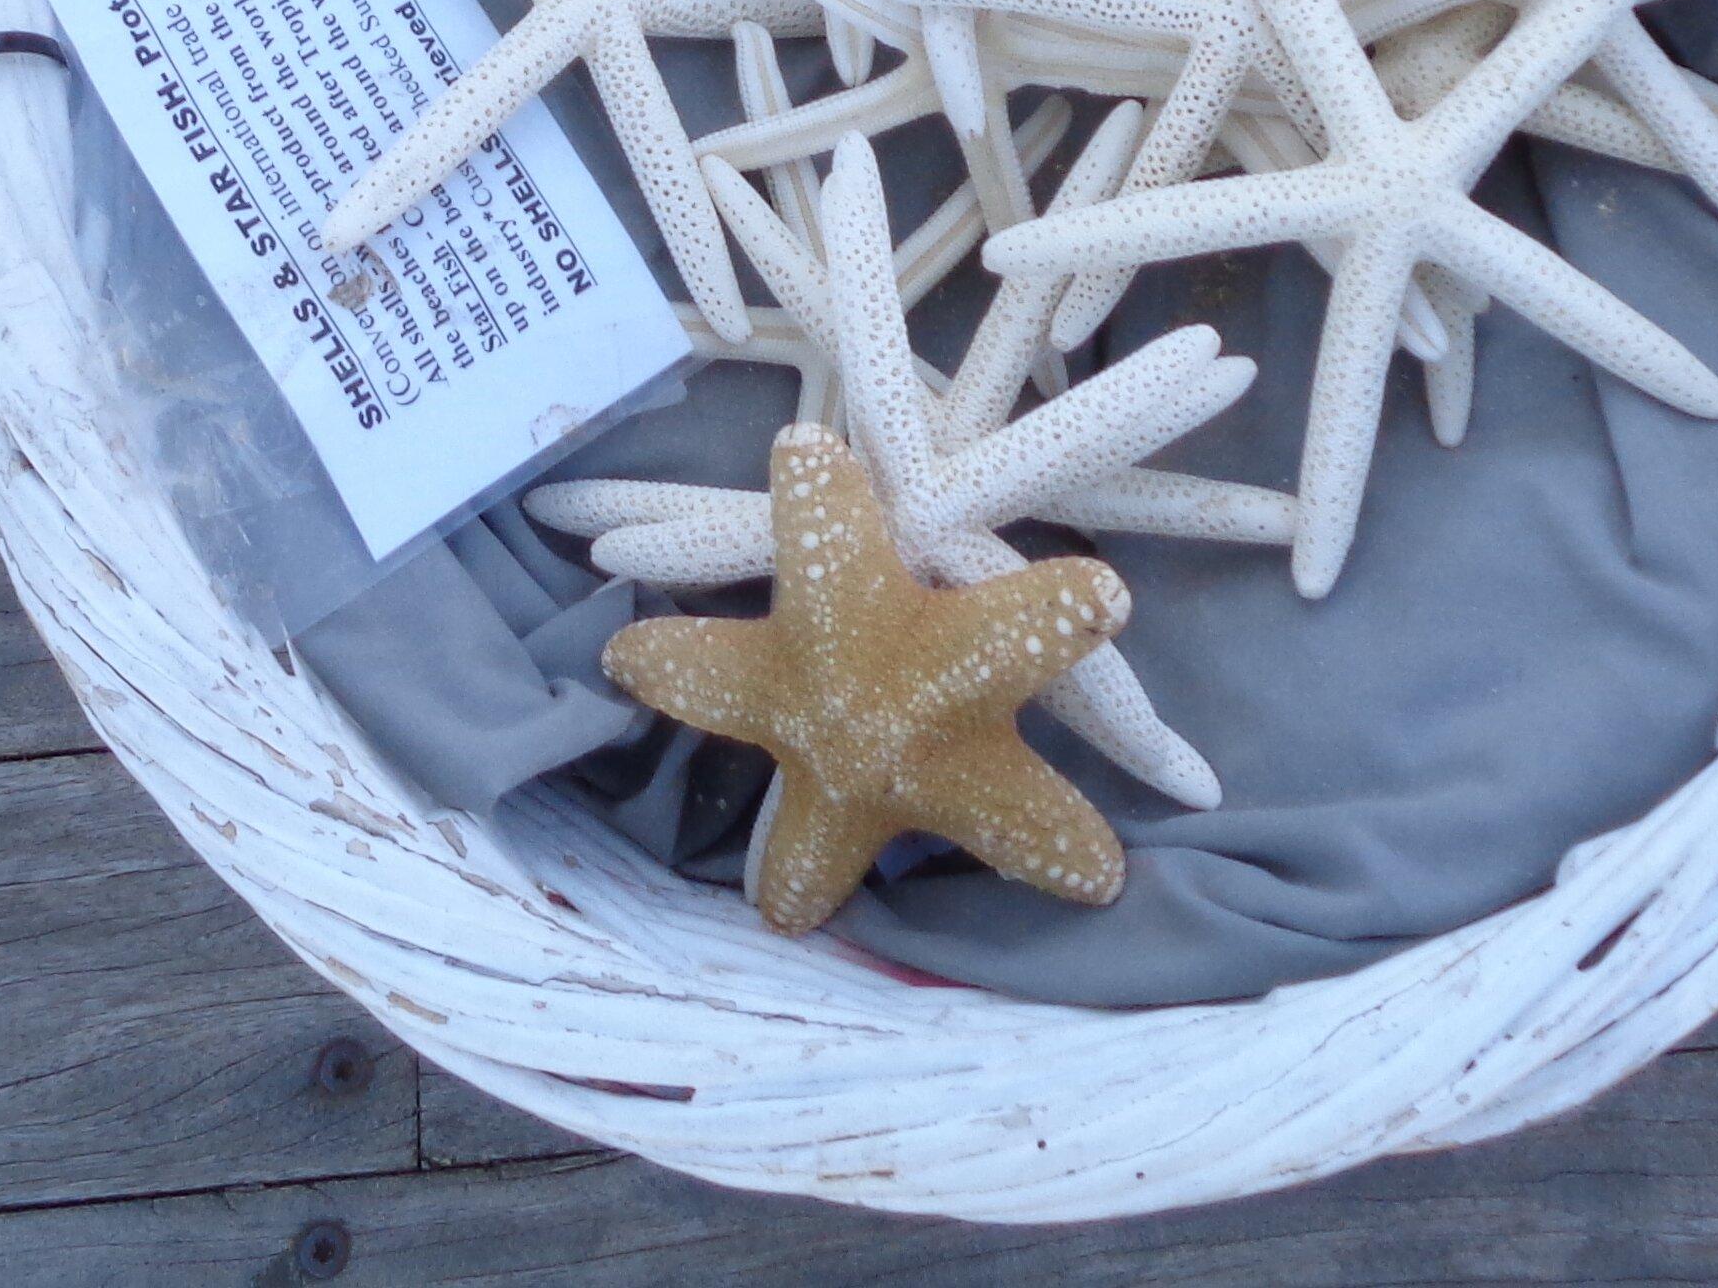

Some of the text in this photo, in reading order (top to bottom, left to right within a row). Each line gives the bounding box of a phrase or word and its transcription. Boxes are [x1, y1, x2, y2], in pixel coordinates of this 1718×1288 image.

[164, 2, 210, 68] trade
[204, 1, 235, 42] the
[321, 12, 351, 53] the
[228, 43, 270, 105] from
[270, 51, 301, 92] the
[314, 69, 360, 123] after
[339, 52, 406, 136] around
[368, 30, 433, 119] hecked
[154, 70, 220, 164] FISH-
[195, 67, 304, 222] international
[288, 92, 355, 176] around
[208, 162, 278, 259] STAR
[477, 129, 561, 247] SHELLS
[294, 218, 326, 254] on
[457, 224, 490, 265] the
[271, 259, 301, 291] &
[385, 234, 452, 332] beaches
[431, 242, 473, 300] Fish
[484, 264, 510, 298] on
[554, 247, 594, 298] NO
[313, 249, 425, 411] (Conveon
[372, 278, 425, 350] shells
[464, 300, 504, 355] Star
[504, 300, 531, 336] up
[291, 290, 384, 432] SHELLS
[412, 346, 449, 384] All
[445, 327, 476, 371] the
